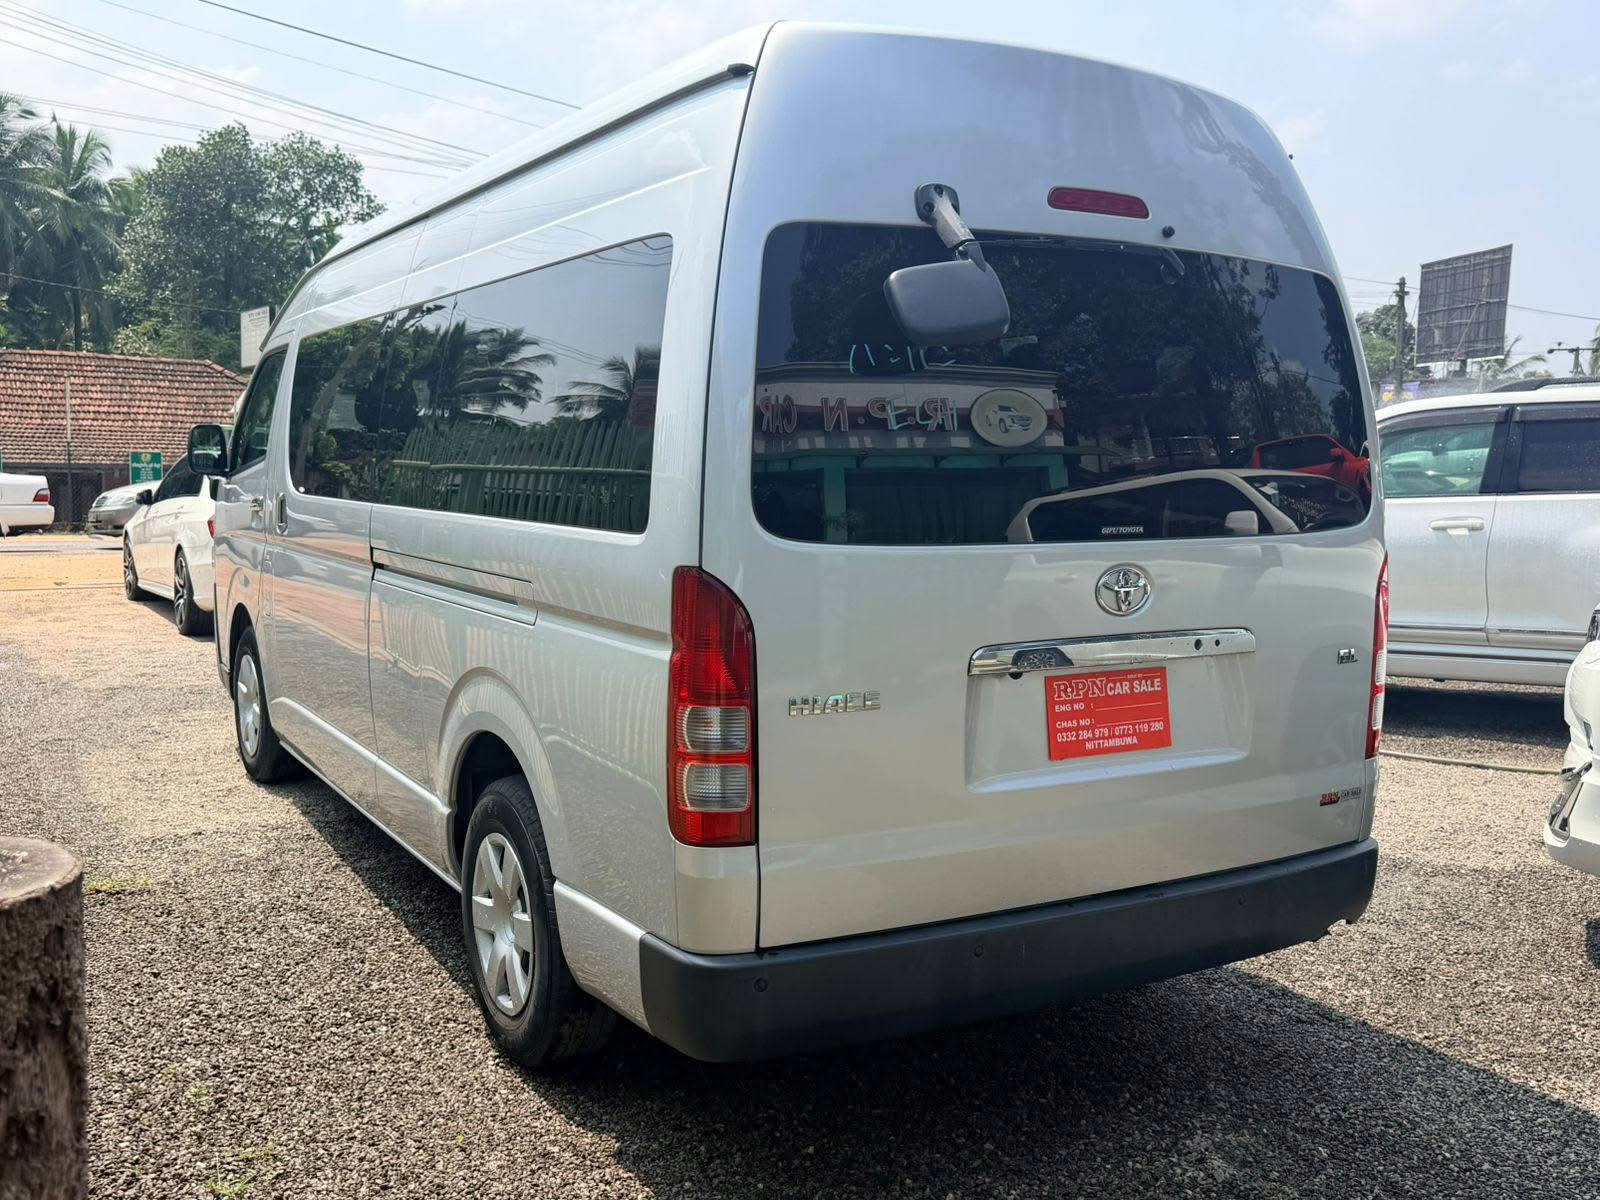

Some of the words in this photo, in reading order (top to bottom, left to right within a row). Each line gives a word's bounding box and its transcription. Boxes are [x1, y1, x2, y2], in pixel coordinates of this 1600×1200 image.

[1106, 681, 1131, 696] CAR
[1133, 678, 1162, 693] SALE
[788, 691, 881, 717] HIACE
[1056, 720, 1078, 729] CHAS
[1056, 731, 1077, 743] 0332
[1078, 729, 1093, 739] 284
[1094, 728, 1109, 738] 979
[1114, 725, 1133, 736] 0773
[1135, 723, 1149, 733] 119
[1085, 736, 1138, 750] NITTAMBUWA
